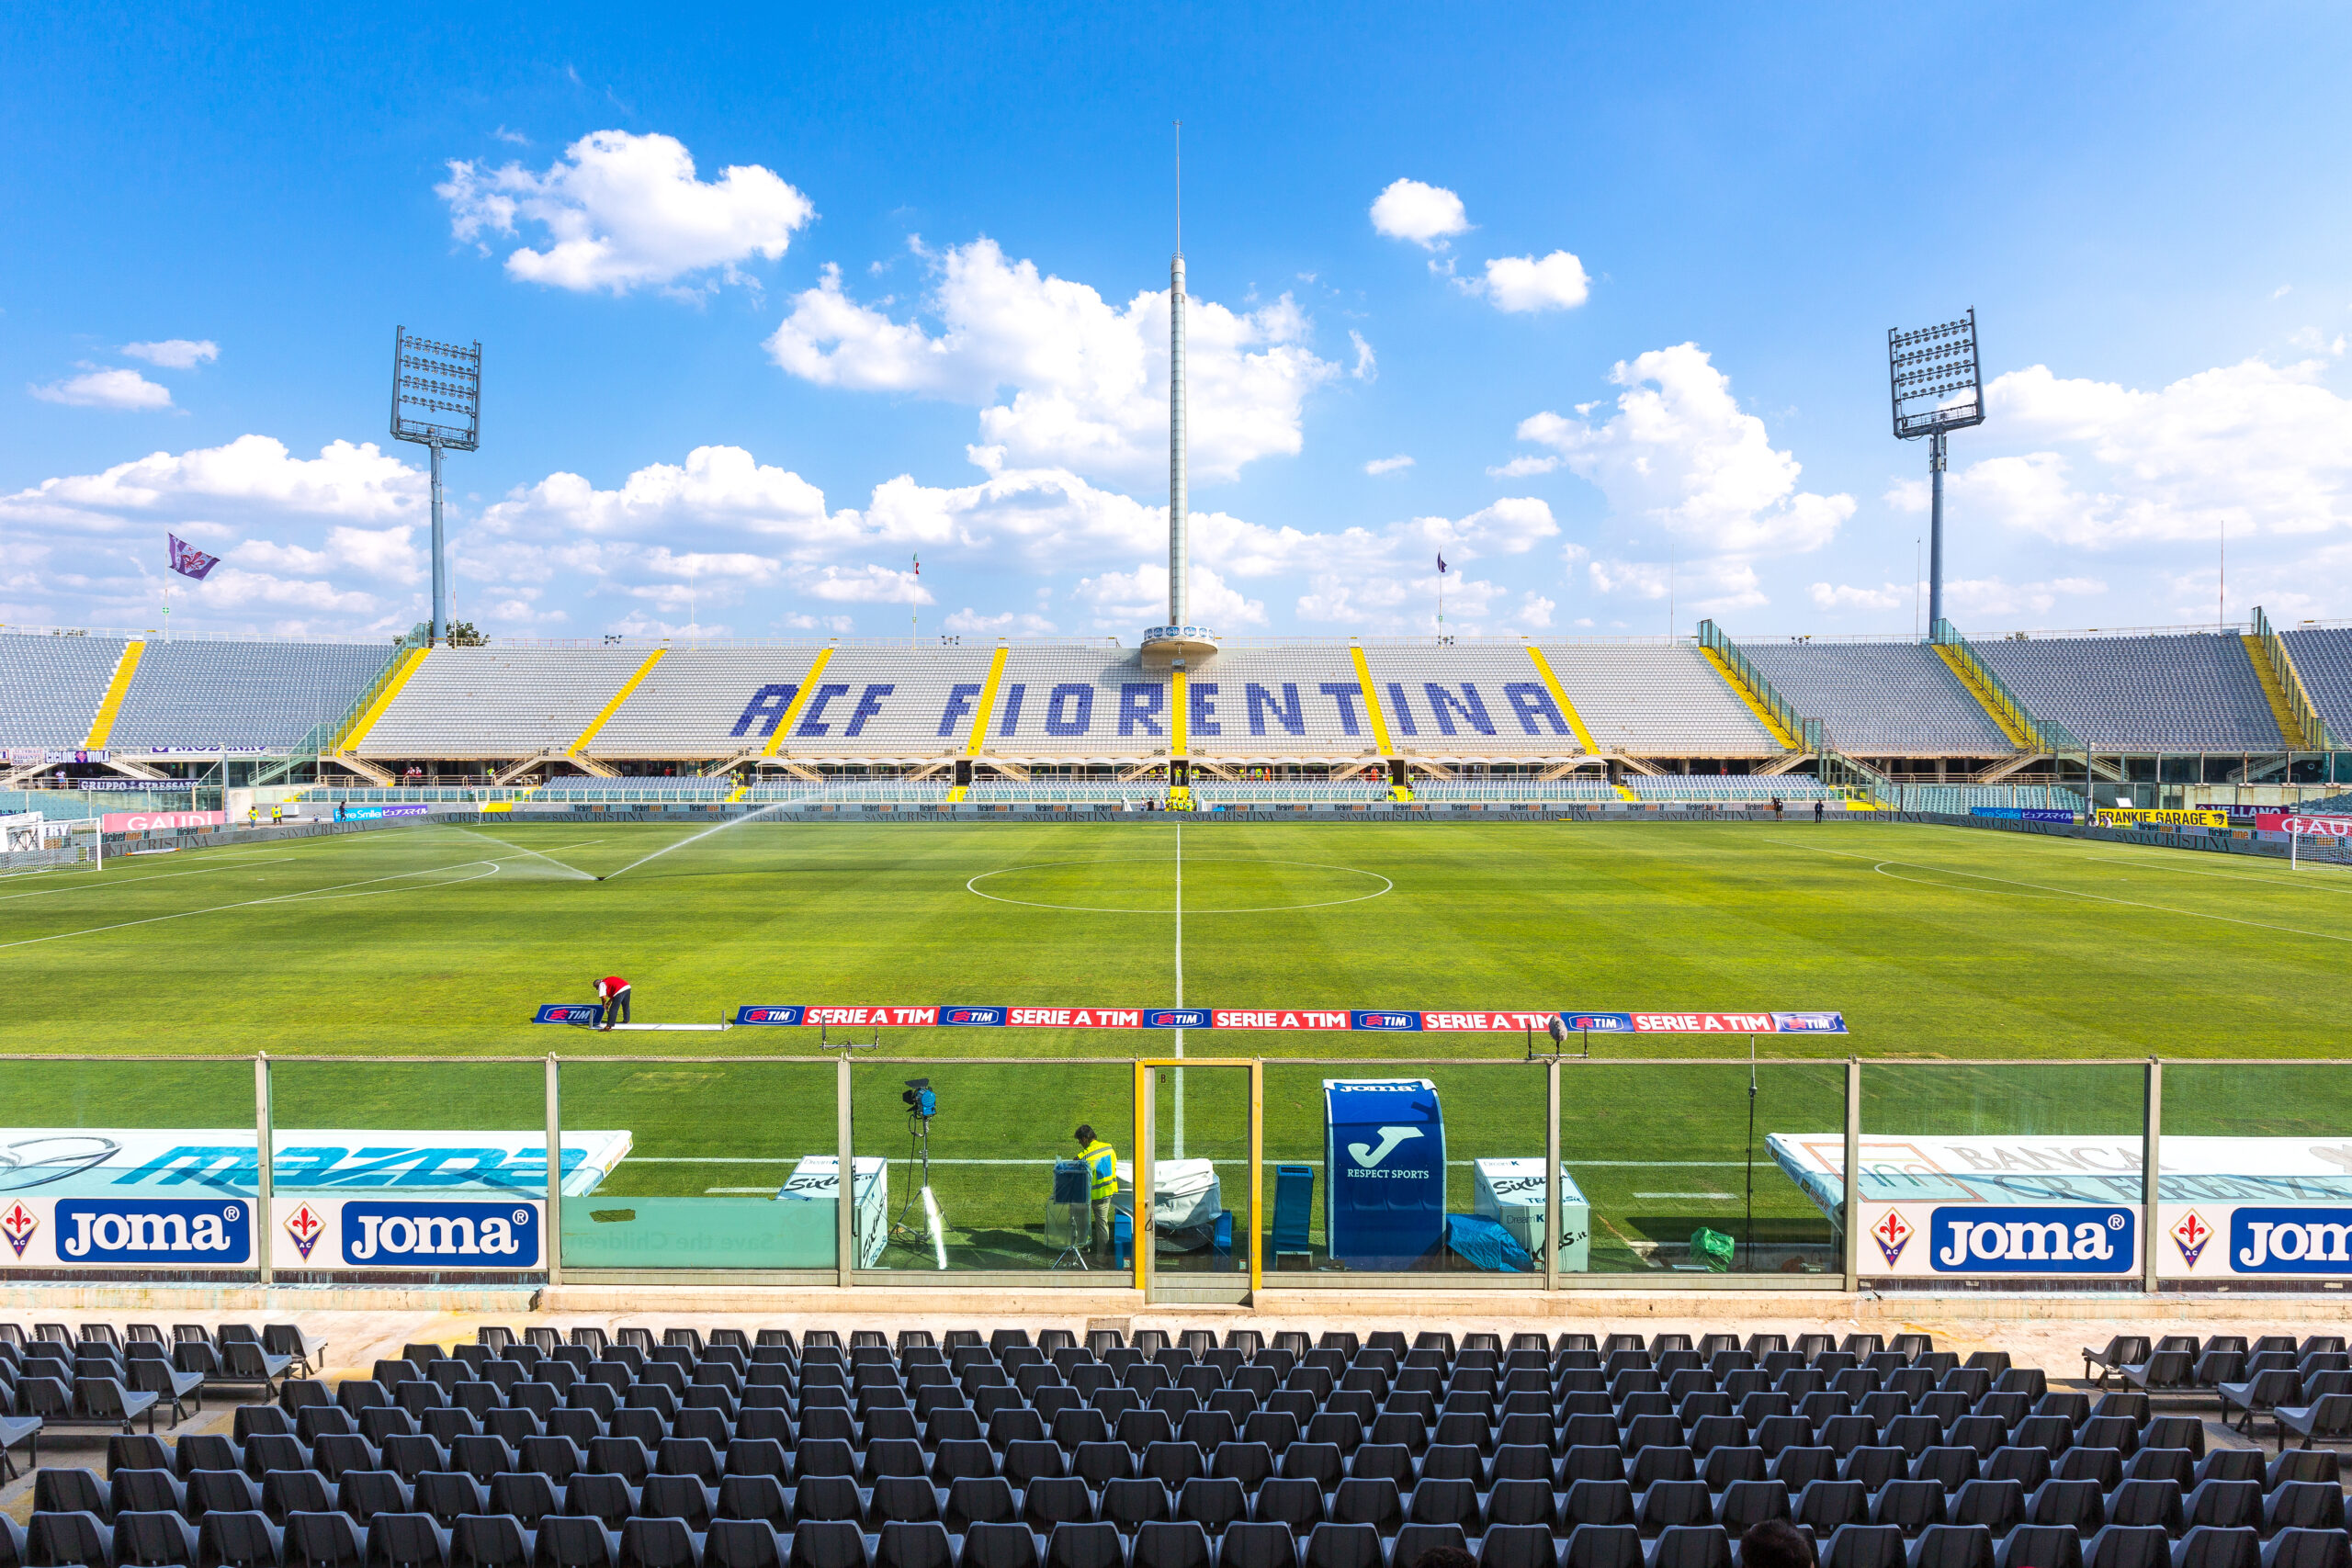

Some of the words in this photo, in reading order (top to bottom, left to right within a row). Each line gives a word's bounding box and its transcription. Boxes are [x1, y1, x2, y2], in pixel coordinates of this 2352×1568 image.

[729, 683, 896, 737] ACF
[936, 682, 1571, 737] FIORENTINA
[86, 750, 110, 762] VIOLA
[81, 780, 127, 791] GRUPPO
[335, 810, 356, 820] Pre
[356, 810, 382, 818] Smile
[585, 812, 643, 822] CRISTINA
[898, 812, 957, 821] CRISTINA
[1056, 812, 1115, 821] CRISTINA
[1181, 812, 1211, 821] SANTA
[1215, 811, 1274, 821] CRISTINA
[1340, 812, 1371, 821] SANTA
[1374, 811, 1433, 821] CRISTINA
[1498, 812, 1531, 821] SANTA
[1532, 811, 1592, 821] CRISTINA
[1658, 812, 1689, 820] SANTA
[1692, 810, 1753, 820] CRISTINA
[2155, 812, 2208, 826] GARAGE
[1992, 818, 2049, 833] CRISTINA
[2115, 830, 2151, 843] SANTA
[2154, 833, 2230, 851] CRISTINA
[568, 1010, 591, 1020] TIM
[767, 1011, 791, 1021] TIM
[808, 1009, 865, 1024] SERIE
[867, 1010, 888, 1024] A
[893, 1009, 935, 1024] TIM
[969, 1012, 993, 1022] TIM
[1011, 1010, 1069, 1025] SERIE
[1074, 1010, 1093, 1025] A
[1096, 1010, 1138, 1026] TIM
[1175, 1014, 1199, 1024] TIM
[1217, 1012, 1275, 1027] SERIE
[1280, 1012, 1299, 1027] A
[1303, 1012, 1346, 1028] TIM
[1383, 1016, 1407, 1027] TIM
[1426, 1013, 1487, 1028] SERIE
[1490, 1014, 1510, 1029] A
[1512, 1014, 1553, 1030] TIM
[1593, 1018, 1617, 1029] TIM
[1636, 1015, 1700, 1030] SERIE
[1704, 1016, 1724, 1030] A
[1729, 1015, 1771, 1030] TIM
[1806, 1019, 1830, 1029] TIM
[1943, 1145, 2179, 1171] BANCA
[1347, 1168, 1389, 1179] RESPECT
[1391, 1169, 1430, 1179] SPORTS
